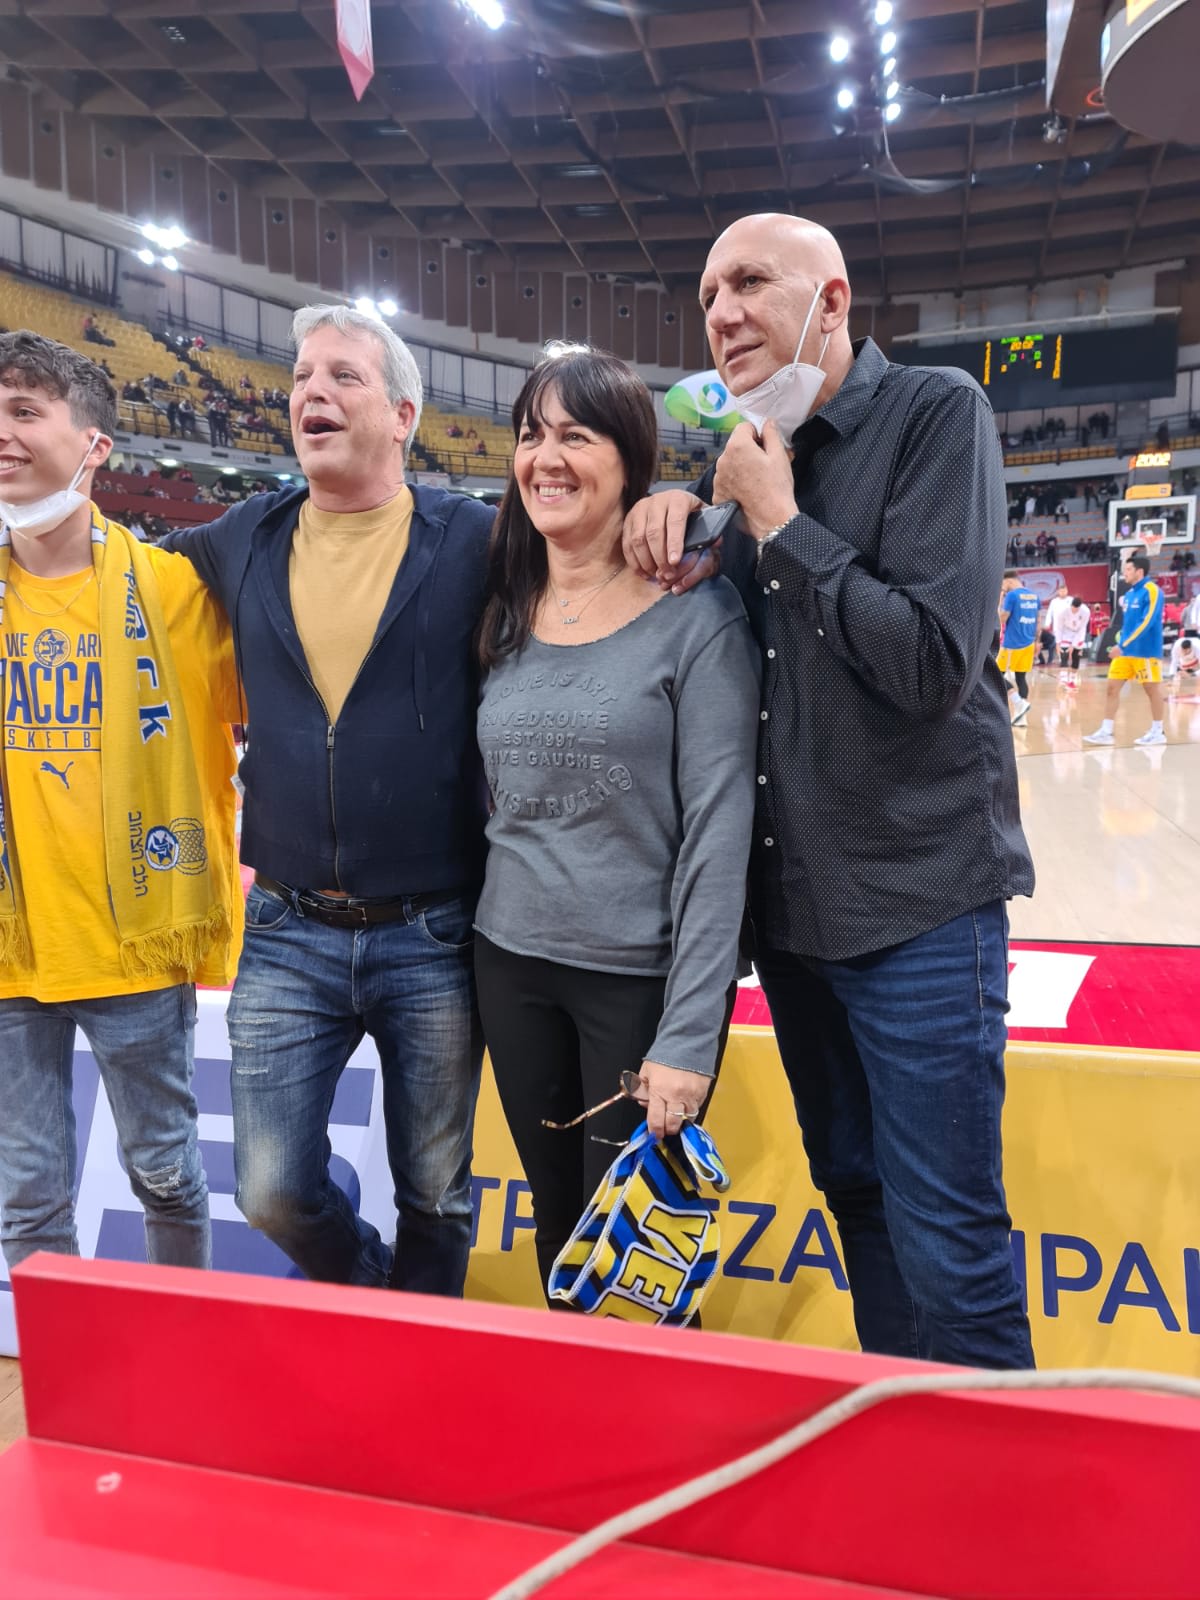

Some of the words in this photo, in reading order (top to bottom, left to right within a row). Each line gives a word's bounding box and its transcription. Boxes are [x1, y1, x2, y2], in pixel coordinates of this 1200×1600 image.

[6, 633, 29, 657] WE
[77, 634, 101, 657] AR
[549, 671, 576, 688] IS
[486, 750, 520, 767] RIVE
[527, 750, 602, 770] GAUCHE
